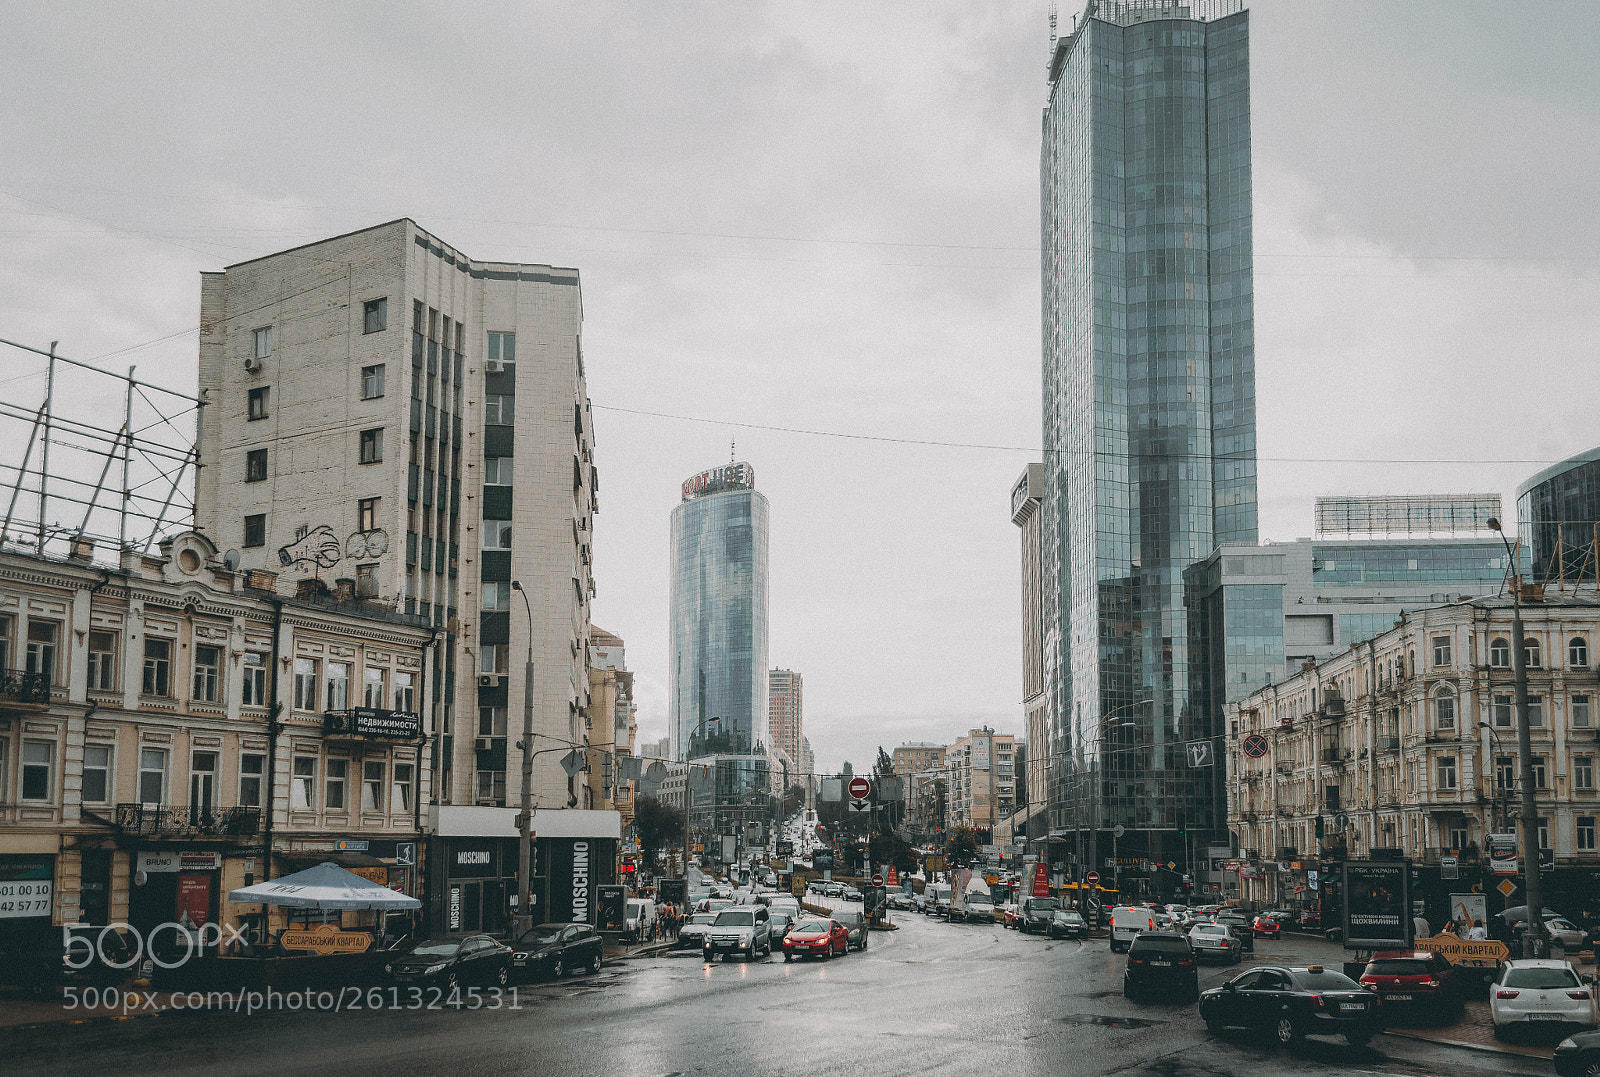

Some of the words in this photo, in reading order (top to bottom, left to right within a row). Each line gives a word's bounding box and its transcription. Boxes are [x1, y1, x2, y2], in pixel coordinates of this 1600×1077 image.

[146, 858, 172, 866] BRUNO
[457, 850, 491, 864] MOSCHINO
[572, 840, 589, 922] MOSCHINO
[0, 885, 15, 896] 01
[18, 885, 32, 896] 00
[36, 885, 49, 895] 10
[1, 901, 14, 911] 42
[18, 900, 32, 911] 57
[35, 900, 48, 910] 77
[450, 887, 461, 929] MOSCHINO
[286, 934, 336, 946] БЕССАРАБСЬКИЙ
[336, 935, 365, 947] КВАРТАЛ
[1462, 945, 1501, 956] КВАРТАЛ
